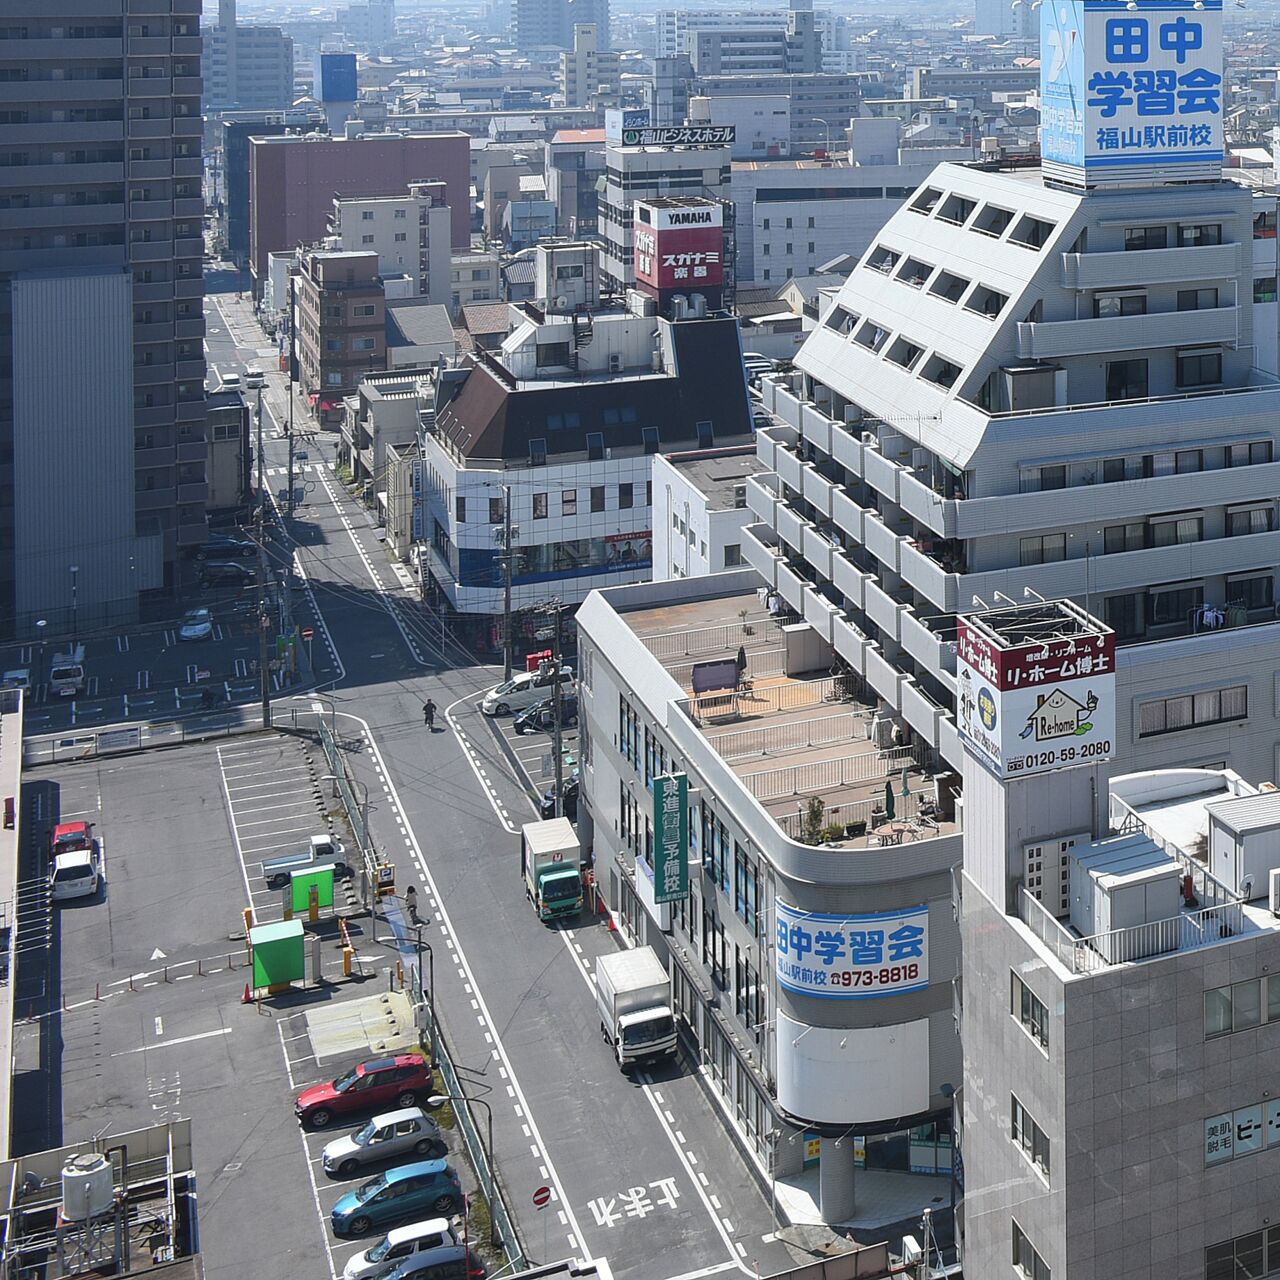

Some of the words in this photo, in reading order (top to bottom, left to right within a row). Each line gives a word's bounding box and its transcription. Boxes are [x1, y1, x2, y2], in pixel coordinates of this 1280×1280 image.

[1105, 16, 1203, 64] 田中
[1087, 67, 1222, 118] 学習会
[640, 127, 734, 145] 福山ビジネスホテル
[1096, 123, 1213, 150] 福山駅前校
[668, 212, 712, 224] YAMAHA
[662, 252, 719, 266] スガナミ
[1007, 654, 1110, 685] リ・ホーム博士
[1040, 715, 1075, 737] Re-home
[1026, 740, 1111, 769] 0120-59-2080
[662, 780, 680, 893] 東進衛星予備校
[776, 916, 925, 965] 田中学習会
[778, 957, 827, 985] 福山駅前校
[841, 963, 919, 987] 973-8818
[1207, 1121, 1232, 1140] 美肌
[1207, 1137, 1232, 1154] 脱毛
[586, 1176, 681, 1228] 止まれ
